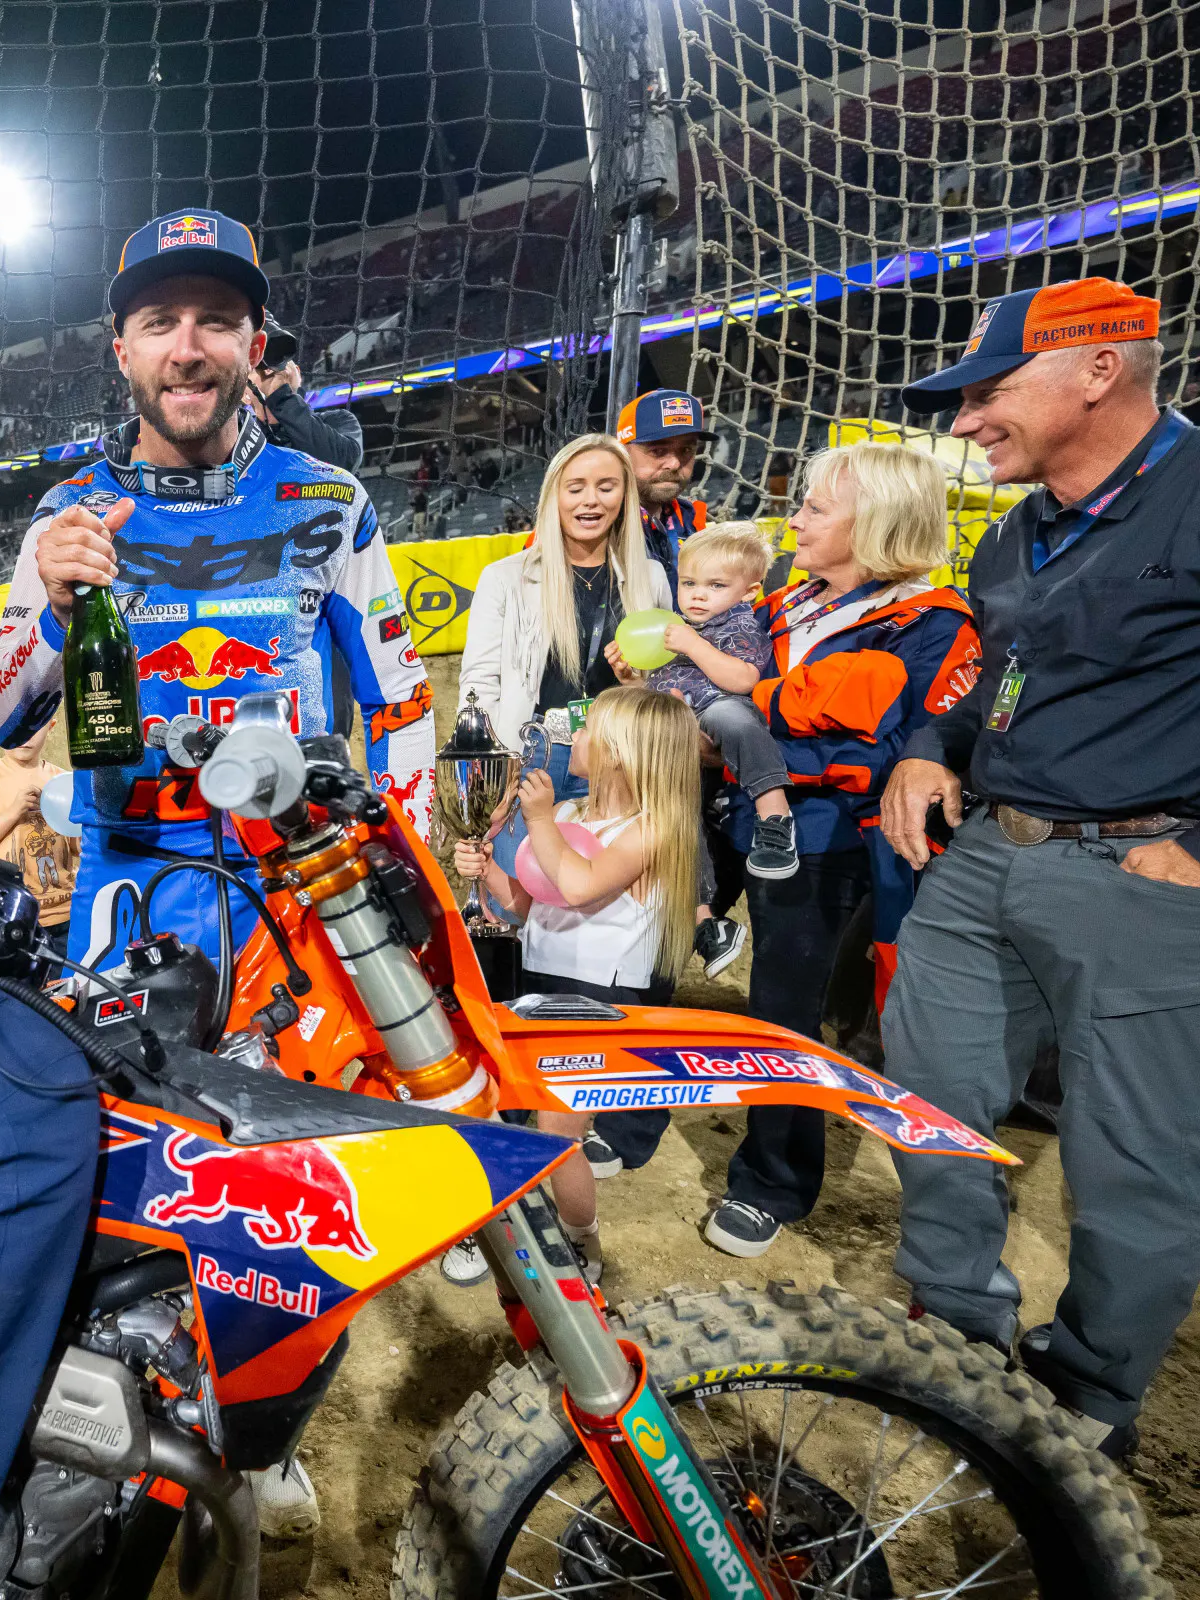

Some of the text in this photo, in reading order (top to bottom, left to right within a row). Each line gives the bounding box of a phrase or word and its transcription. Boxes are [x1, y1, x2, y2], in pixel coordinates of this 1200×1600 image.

[161, 231, 215, 250] Red Bull
[1033, 318, 1145, 345] FACTORY RACING
[158, 487, 200, 496] FACTORY PILOT
[116, 592, 188, 617] PARADISE
[221, 600, 291, 615] MOTOREX
[16, 625, 39, 668] Bull
[88, 713, 115, 725] 450
[95, 724, 133, 736] Place
[540, 1053, 602, 1066] DECAL
[676, 1051, 835, 1086] Red Bull
[572, 1084, 714, 1108] PROGRESSIVE
[197, 1253, 321, 1319] Red Bull
[673, 1361, 858, 1392] DUNLOP
[693, 1384, 722, 1399] DID
[655, 1454, 755, 1600] MOTOREX
